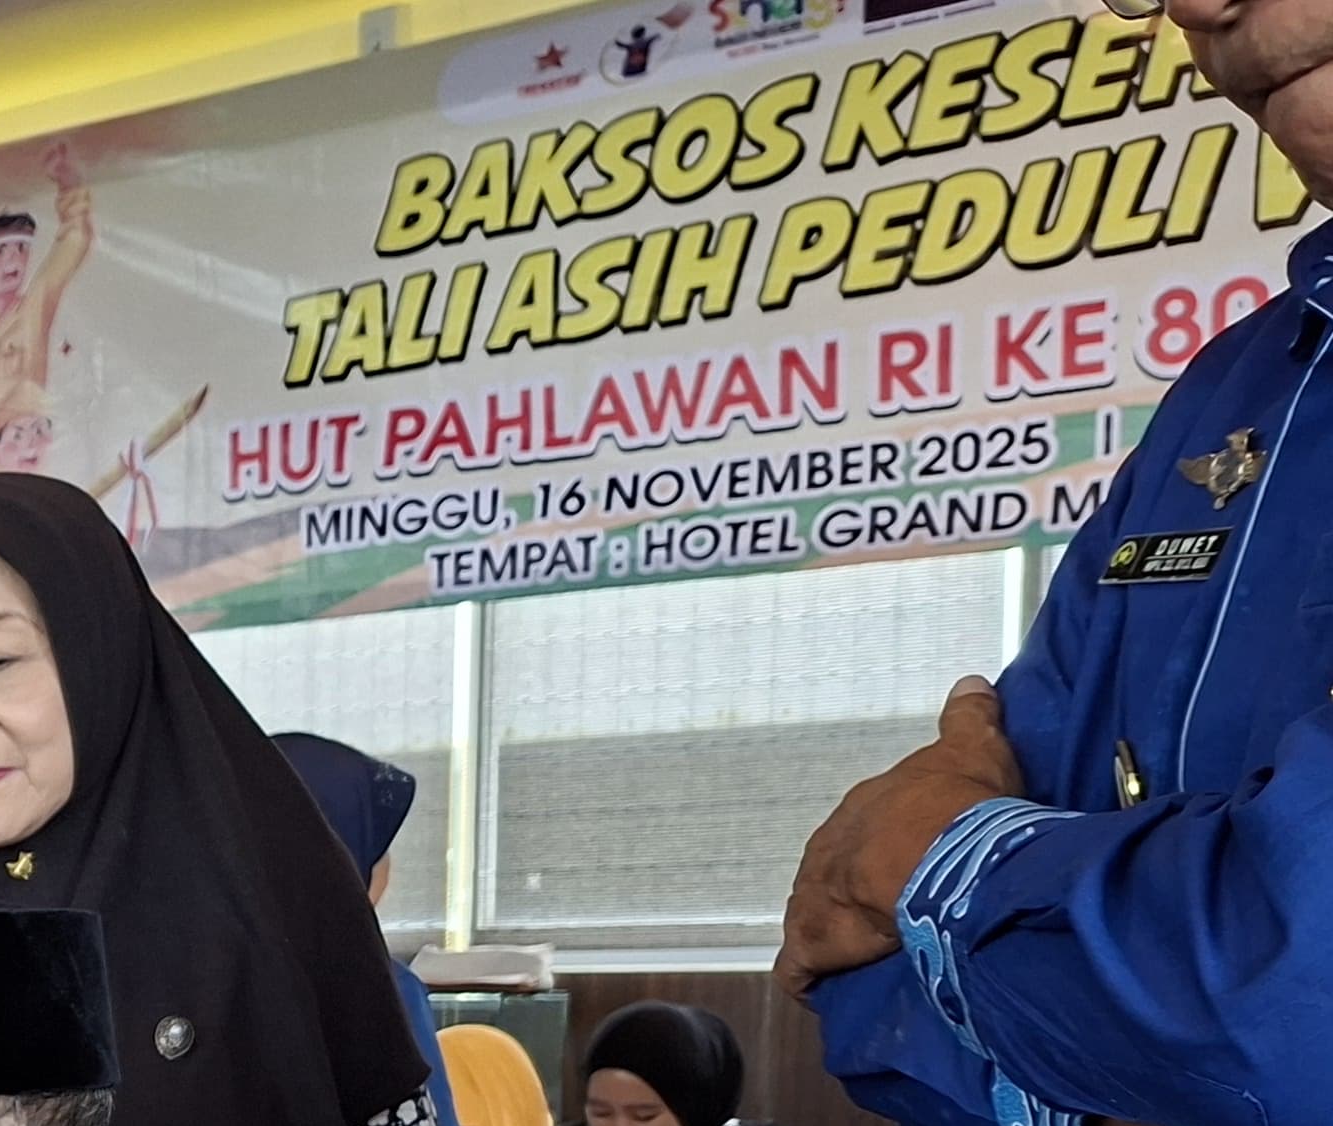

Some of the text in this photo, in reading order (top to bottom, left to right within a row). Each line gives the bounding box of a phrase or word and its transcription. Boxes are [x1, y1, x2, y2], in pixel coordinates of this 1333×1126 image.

[284, 262, 488, 388] TALI
[485, 214, 757, 353] ASIH
[758, 123, 1238, 313] PEDULI
[375, 73, 821, 257] BAKSOS
[228, 275, 1270, 491] HUT PAHLAWAN RI KE 80
[305, 487, 513, 548] MINGGU,
[539, 480, 585, 519] 16
[604, 441, 899, 513] NOVEMBER
[917, 421, 1050, 477] 2025
[430, 535, 598, 589] TEMPAT
[644, 516, 799, 567] HOTEL
[817, 491, 1027, 549] GRAND
